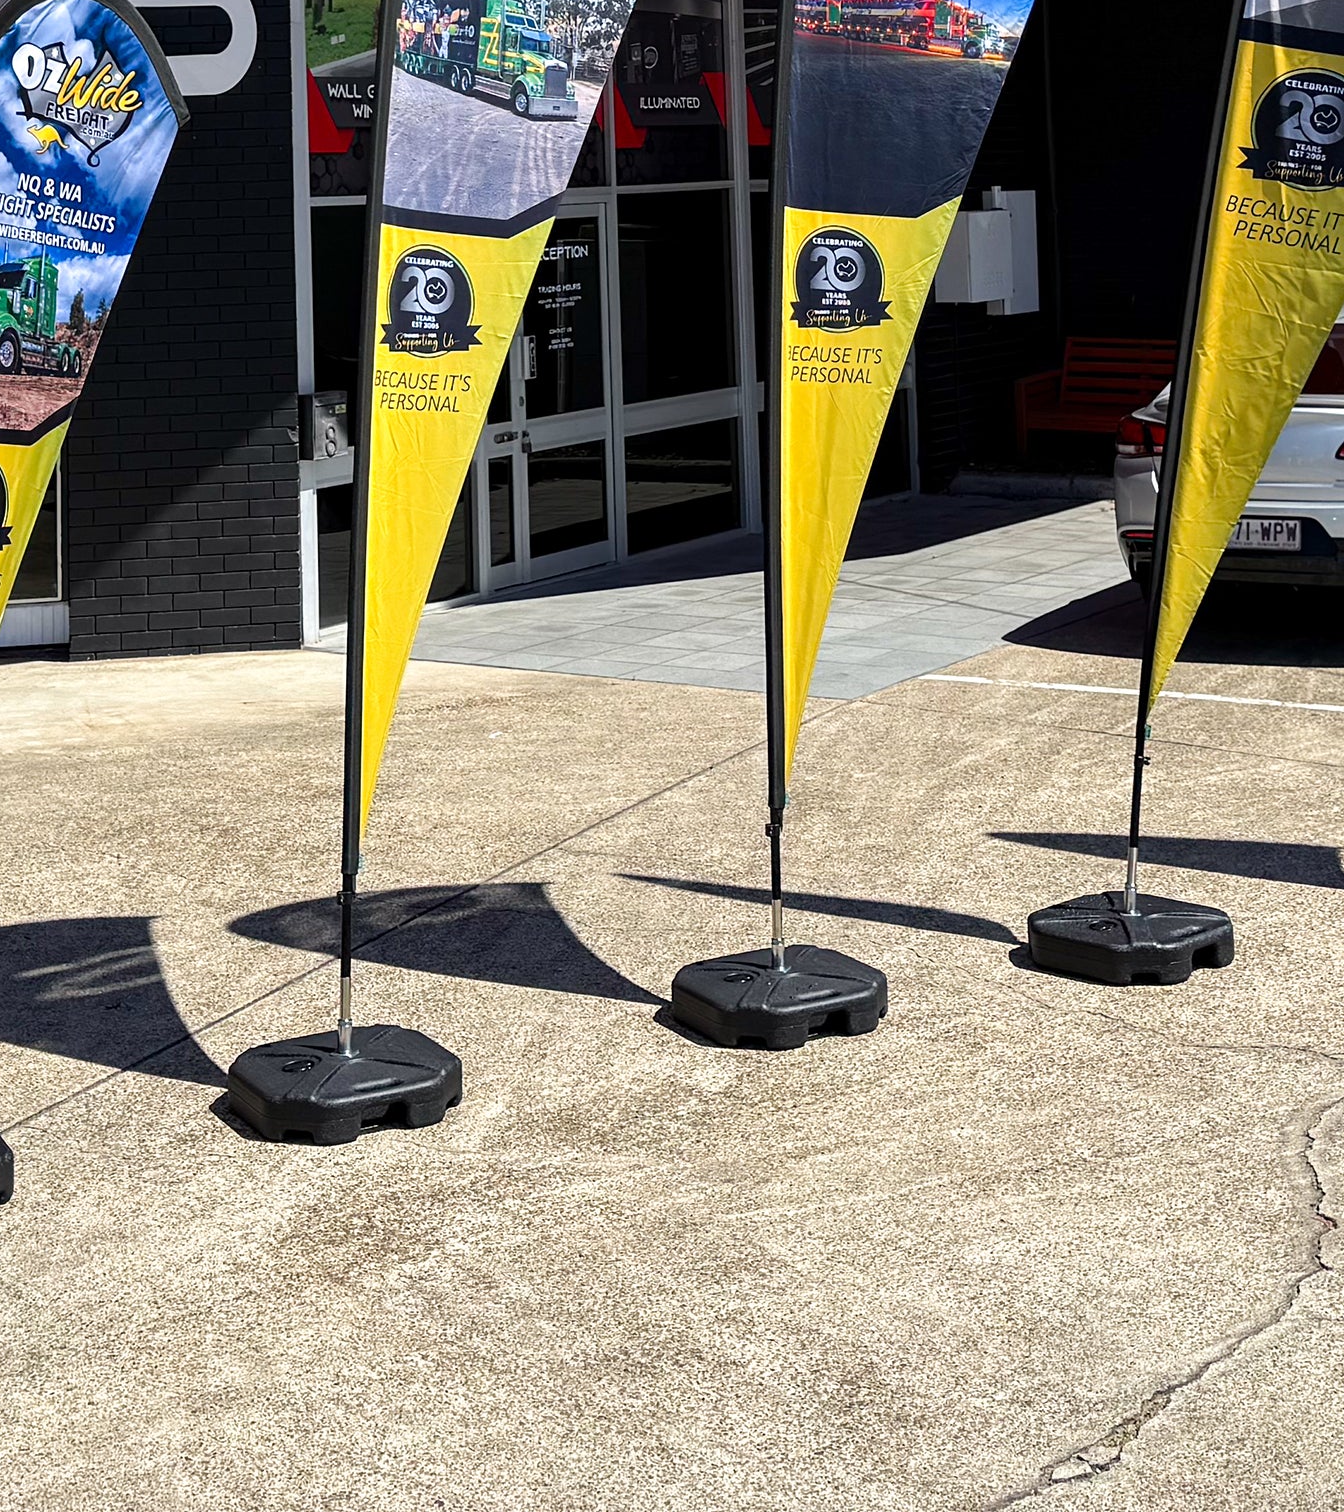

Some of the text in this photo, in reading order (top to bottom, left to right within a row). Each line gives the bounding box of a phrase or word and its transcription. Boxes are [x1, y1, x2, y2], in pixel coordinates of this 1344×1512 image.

[327, 83, 362, 99] WALL
[639, 97, 701, 109] ILLUMINATED
[45, 102, 111, 131] FREIGHT
[1288, 149, 1327, 162] EST 2005
[1295, 142, 1323, 153] YEARS
[1264, 160, 1324, 185] Supporting
[17, 172, 83, 203] NQ & WA
[36, 203, 117, 234] SPECIALISTS
[1226, 194, 1320, 229] BECAUSE
[812, 237, 864, 248] CELEBRATING
[1233, 219, 1342, 255] PERSONAL
[405, 256, 454, 268] CELEBRATING
[809, 246, 867, 292] 20
[400, 266, 456, 314] 20
[856, 348, 883, 365] IT'S
[374, 369, 472, 392] BECAUSE IT'S
[790, 365, 872, 384] PERSONAL
[380, 392, 460, 413] PERSONAL
